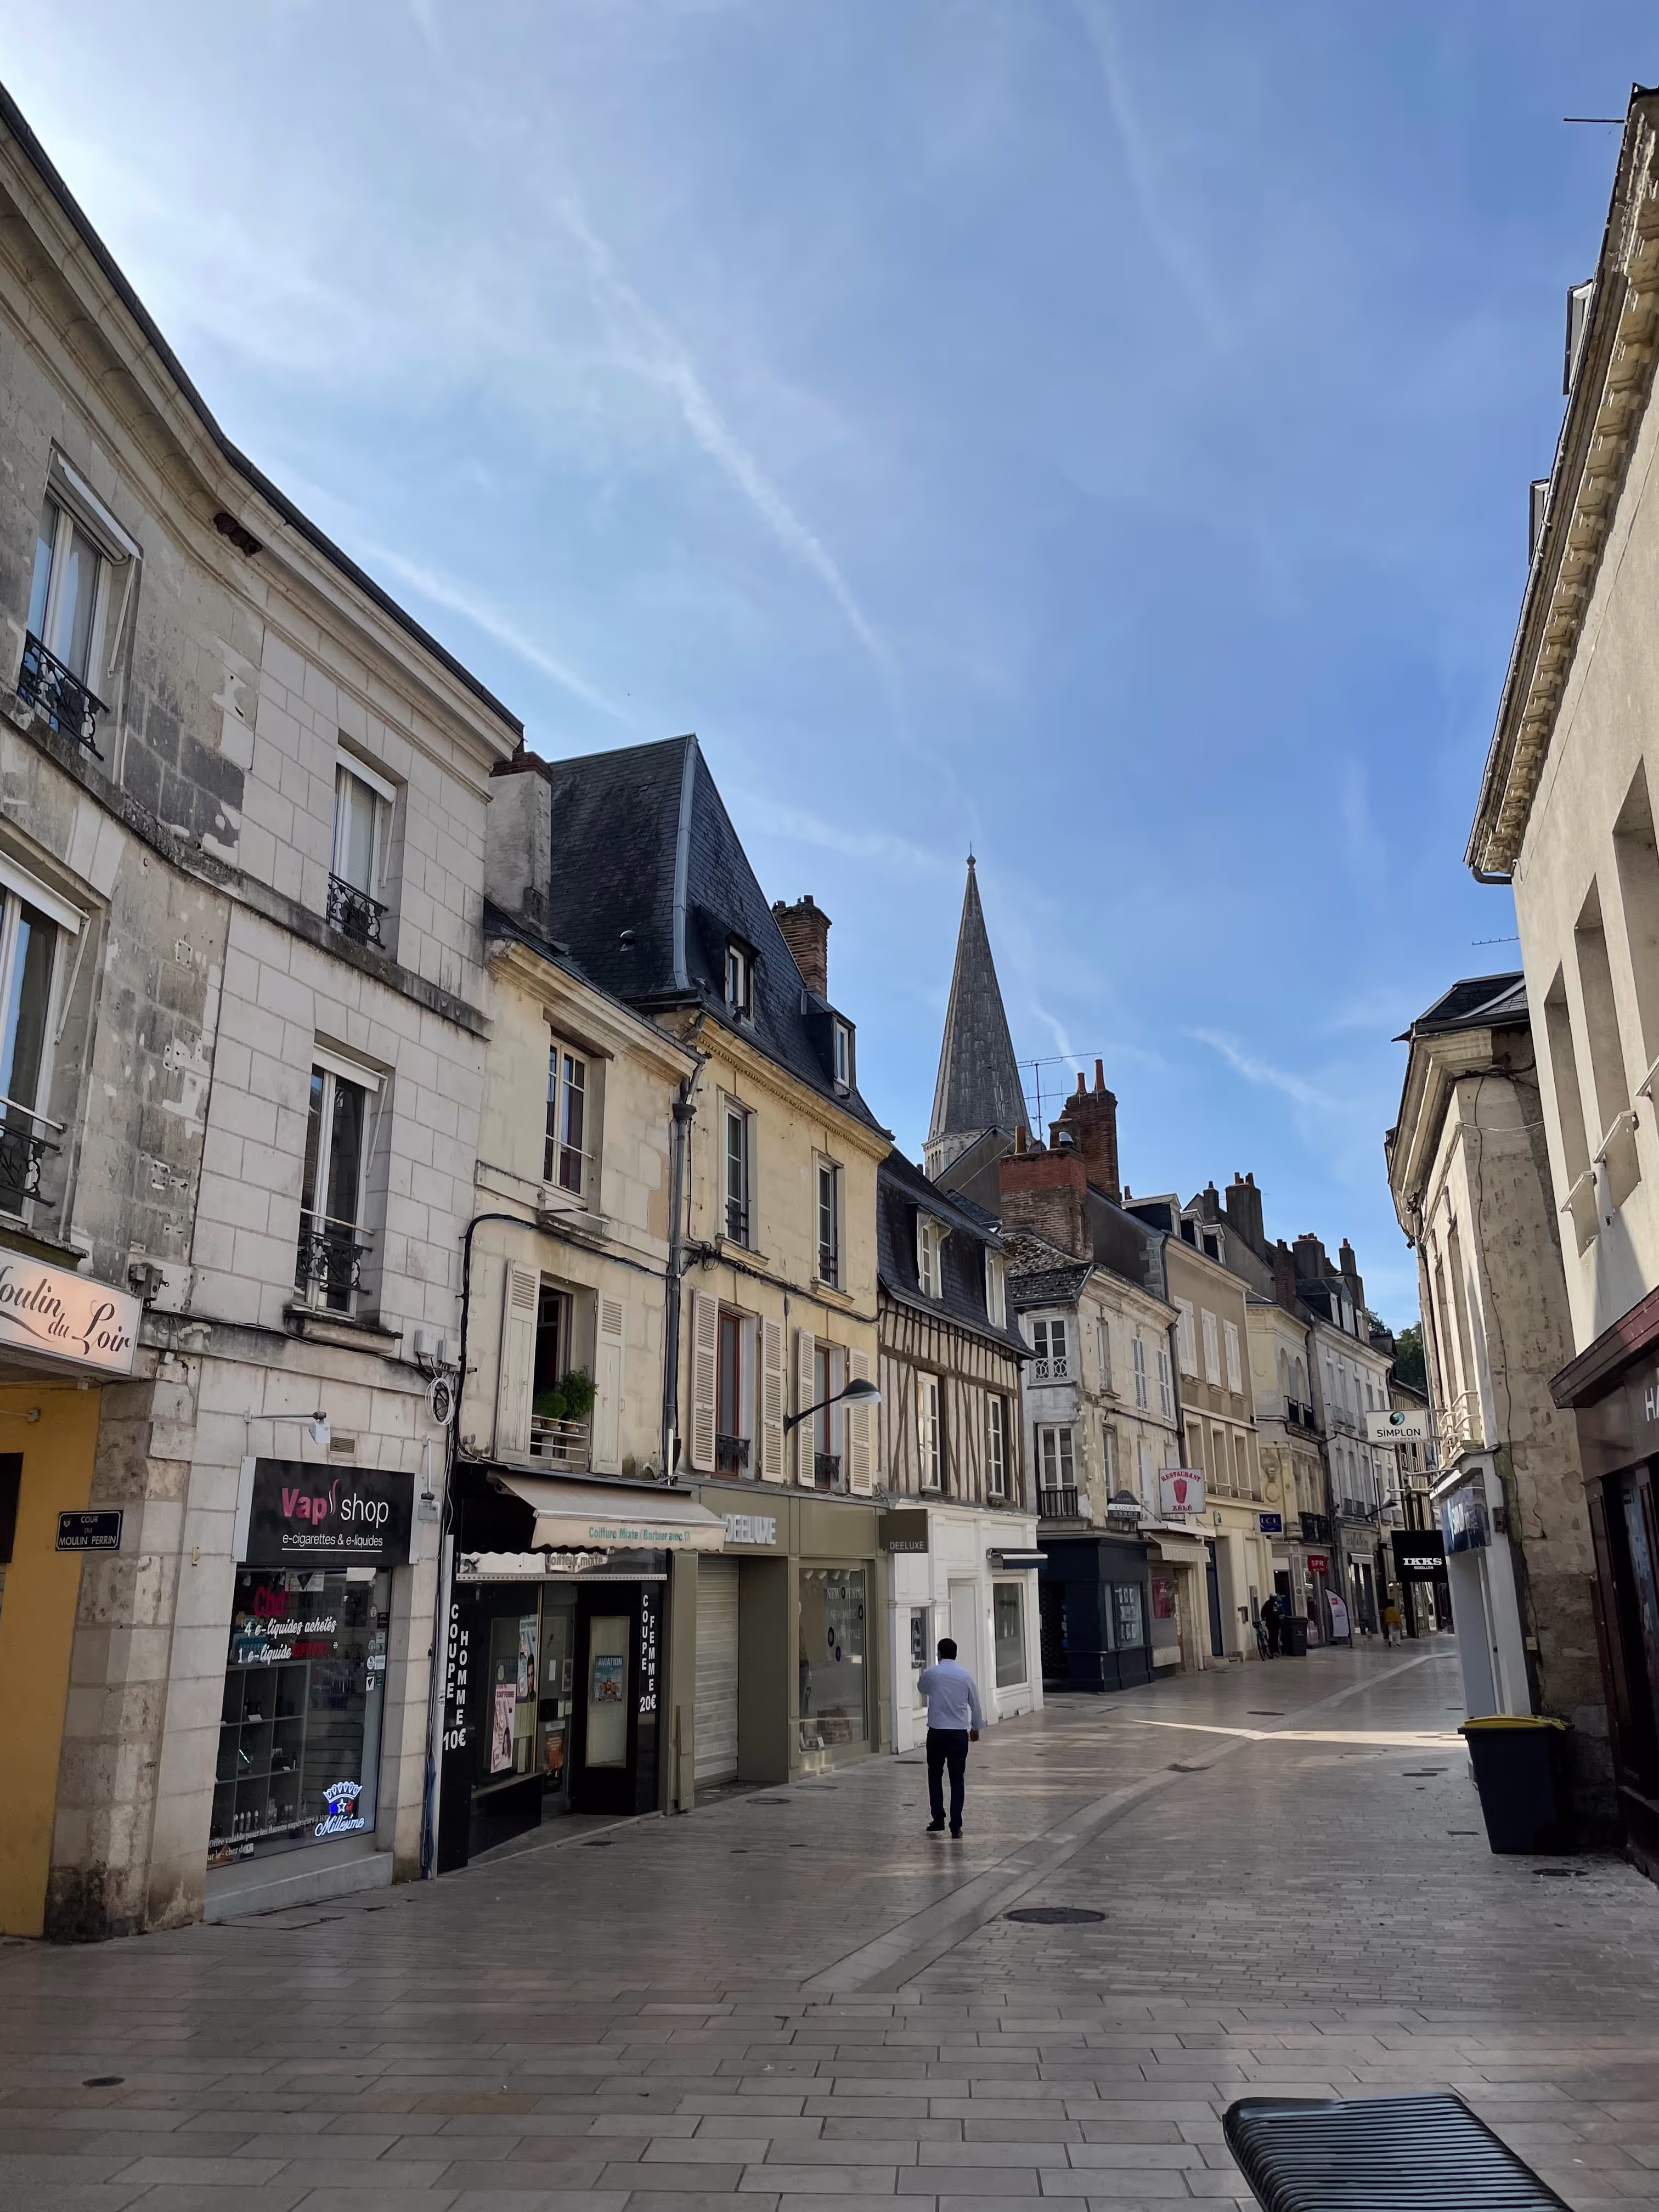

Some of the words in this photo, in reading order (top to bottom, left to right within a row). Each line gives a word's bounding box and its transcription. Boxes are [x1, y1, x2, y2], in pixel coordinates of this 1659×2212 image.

[48, 1313, 70, 1338] du
[71, 1300, 131, 1355] Loir
[1161, 1471, 1201, 1482] RESTAURANT
[281, 1487, 328, 1525] Vap
[341, 1492, 389, 1529] shop
[589, 1527, 617, 1539] Coiffure
[619, 1528, 639, 1539] Mixte
[644, 1529, 668, 1541] Barbier
[721, 1511, 776, 1545] DEELUXE
[59, 1536, 88, 1545] MOULIN
[91, 1536, 116, 1545] PERRIN
[282, 1532, 336, 1547] e-cigarettes
[337, 1534, 344, 1545] &
[346, 1534, 383, 1549] e-liquides
[889, 1541, 924, 1550] DEELUXE
[1403, 1558, 1442, 1566] IKKS
[244, 1622, 252, 1637] 4
[255, 1618, 303, 1639] e-liquides
[304, 1616, 337, 1634] achetés
[238, 1648, 244, 1663] 1
[248, 1644, 292, 1666] e-liquide
[447, 1604, 459, 1699] COUPE
[456, 1630, 469, 1725] HOMME
[640, 1694, 657, 1712] 20€
[443, 1728, 466, 1751] 10€
[314, 1813, 365, 1837] Millésime
[209, 1838, 224, 1848] Offre
